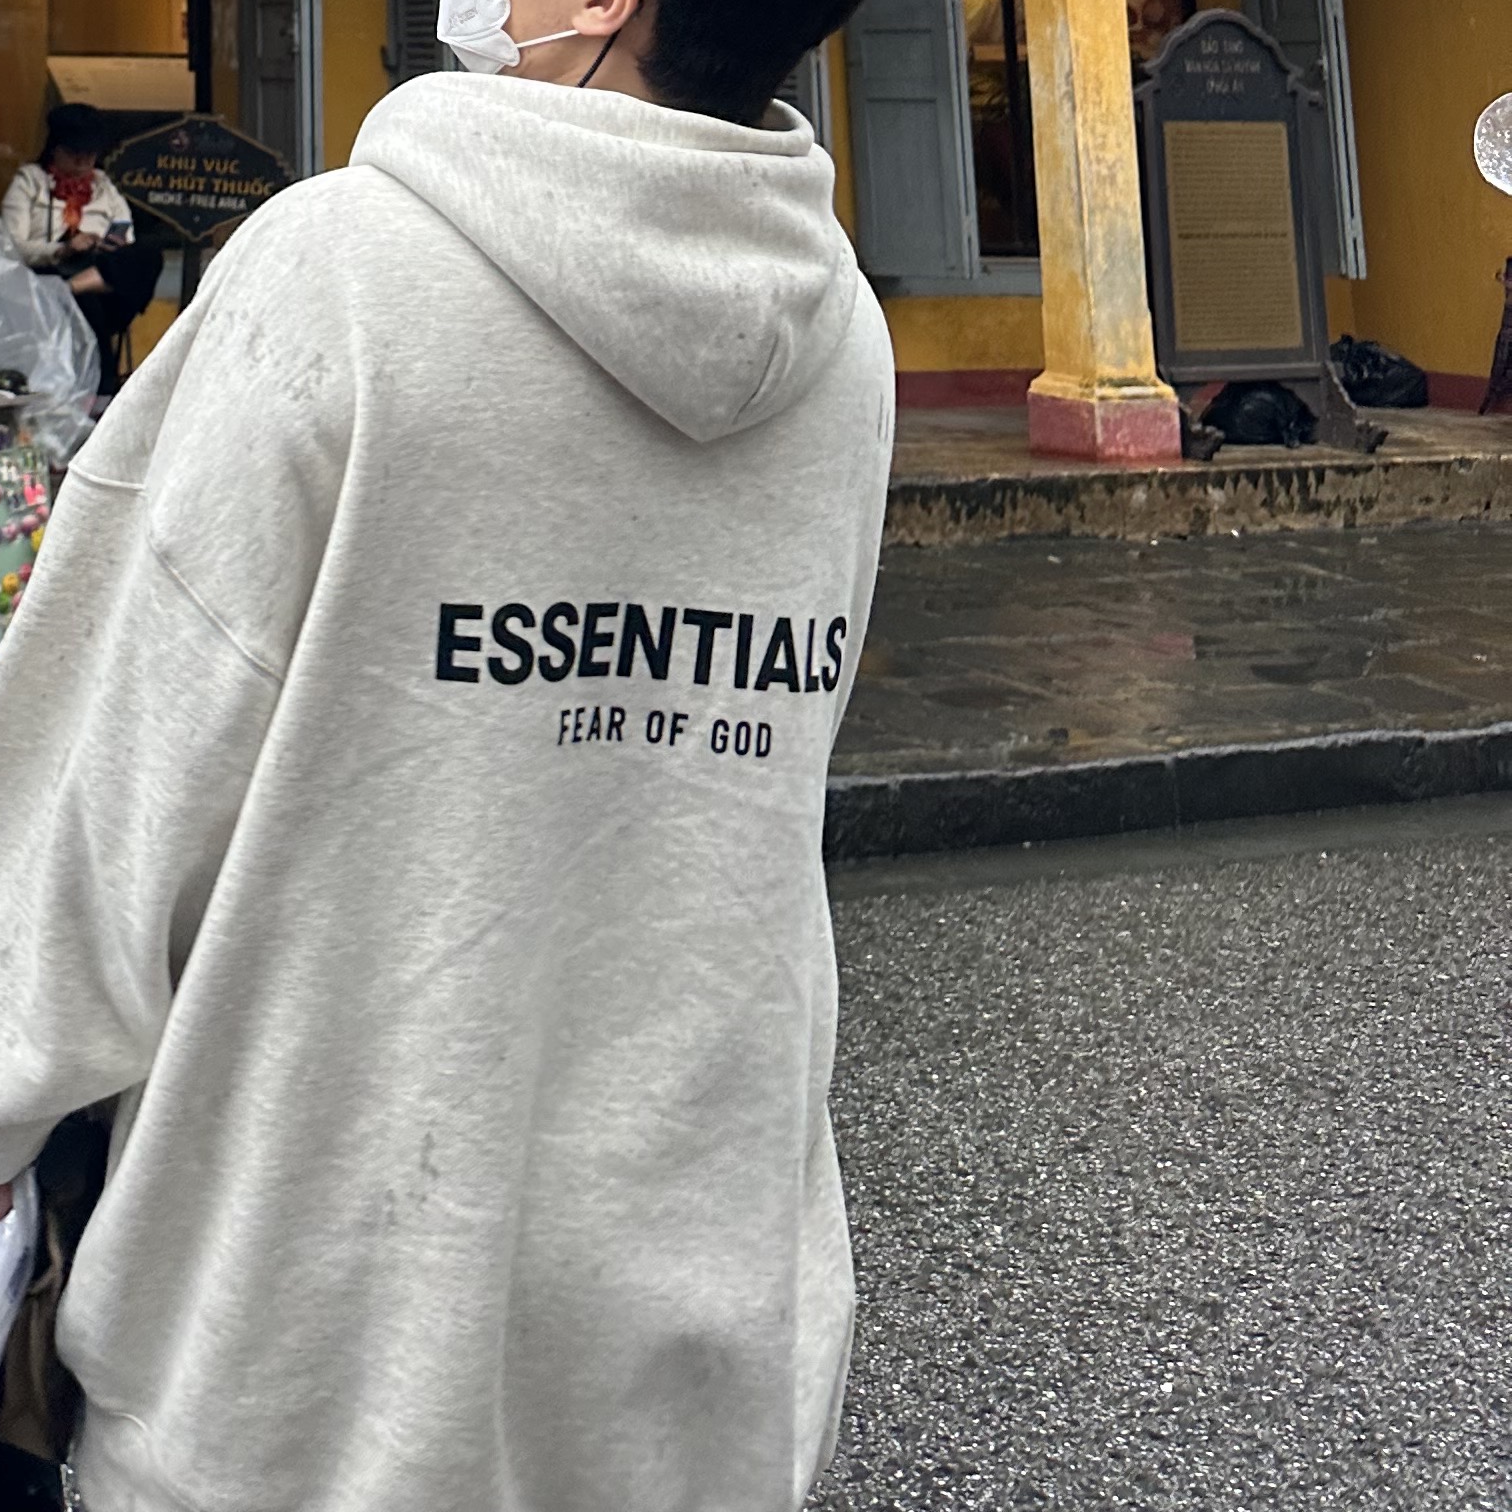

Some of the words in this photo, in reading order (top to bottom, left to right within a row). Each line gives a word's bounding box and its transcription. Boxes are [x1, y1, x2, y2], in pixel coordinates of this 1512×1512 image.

[156, 154, 197, 172] KHU
[435, 601, 848, 693] ESSENTIALS
[556, 706, 626, 746] FEAR
[645, 710, 690, 746] OF
[710, 719, 773, 758] GOD
